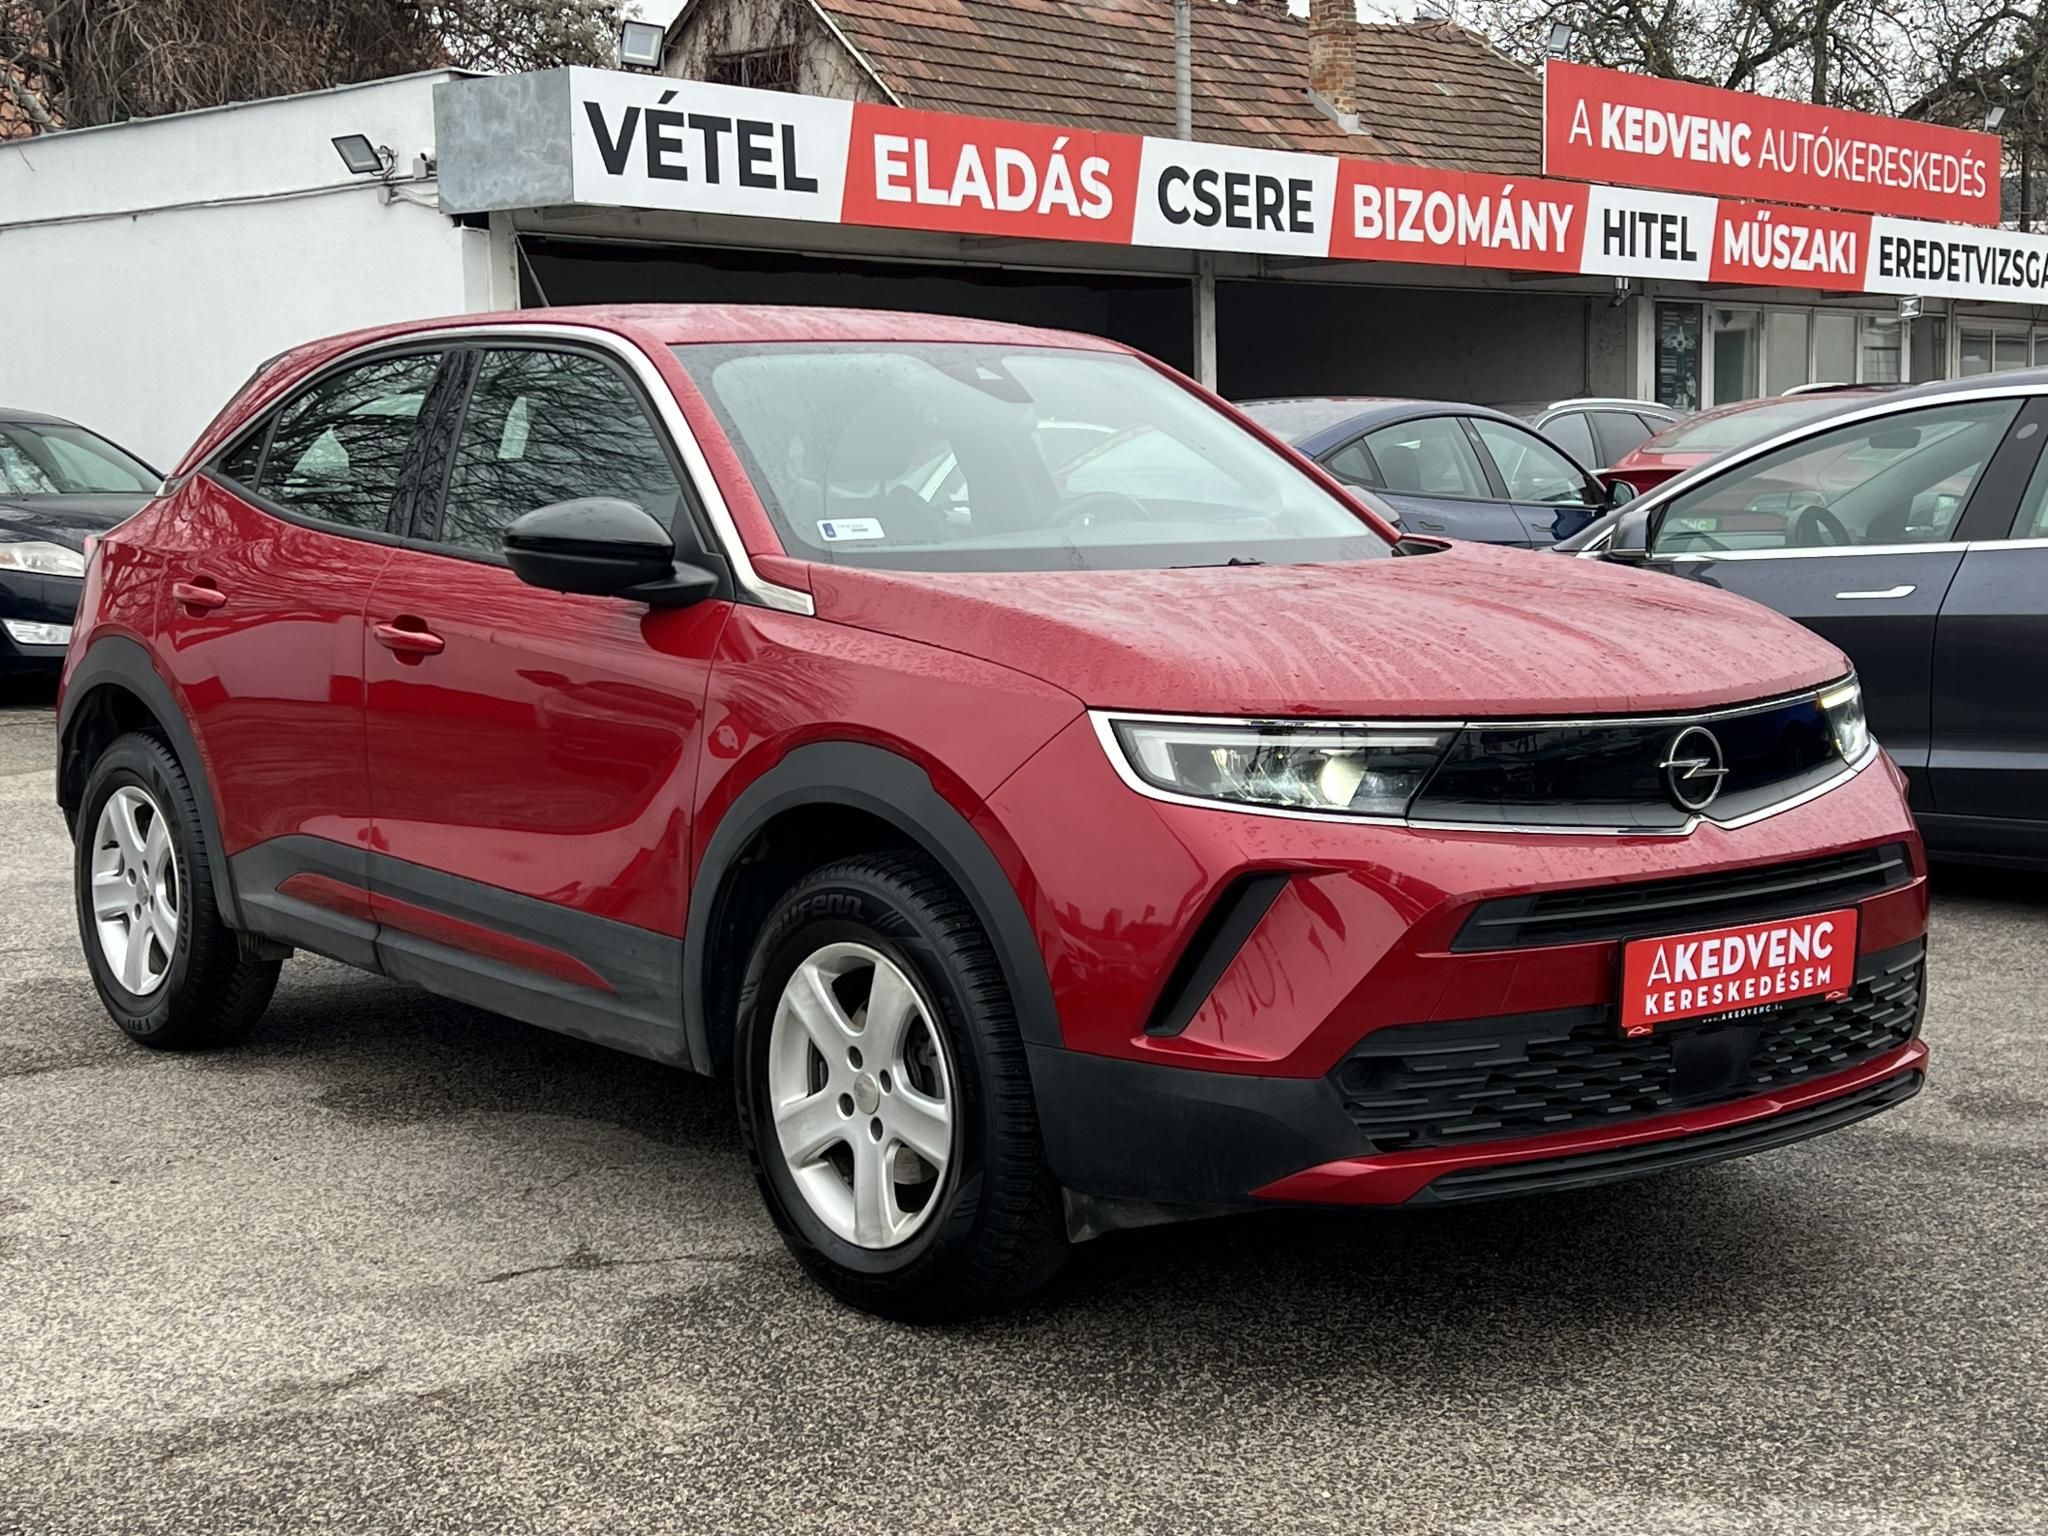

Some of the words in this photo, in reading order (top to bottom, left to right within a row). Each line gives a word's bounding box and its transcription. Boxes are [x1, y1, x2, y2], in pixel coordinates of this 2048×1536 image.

[583, 90, 819, 194] VÉTEL
[873, 135, 1113, 220] ELADÁS
[1158, 165, 1314, 234] CSERE
[1353, 183, 1574, 253] BIZOMÁNY
[1603, 208, 1697, 262] HITEL
[1724, 210, 1856, 274] MŰSZAKI
[1568, 99, 1593, 147] A
[1601, 102, 1752, 168] KEDVENC
[1758, 126, 1987, 198] AUTÓKERESKEDÉS
[1644, 964, 1832, 1015] KERESKEDÉSEM
[1647, 921, 1835, 987] AKEDVENC
